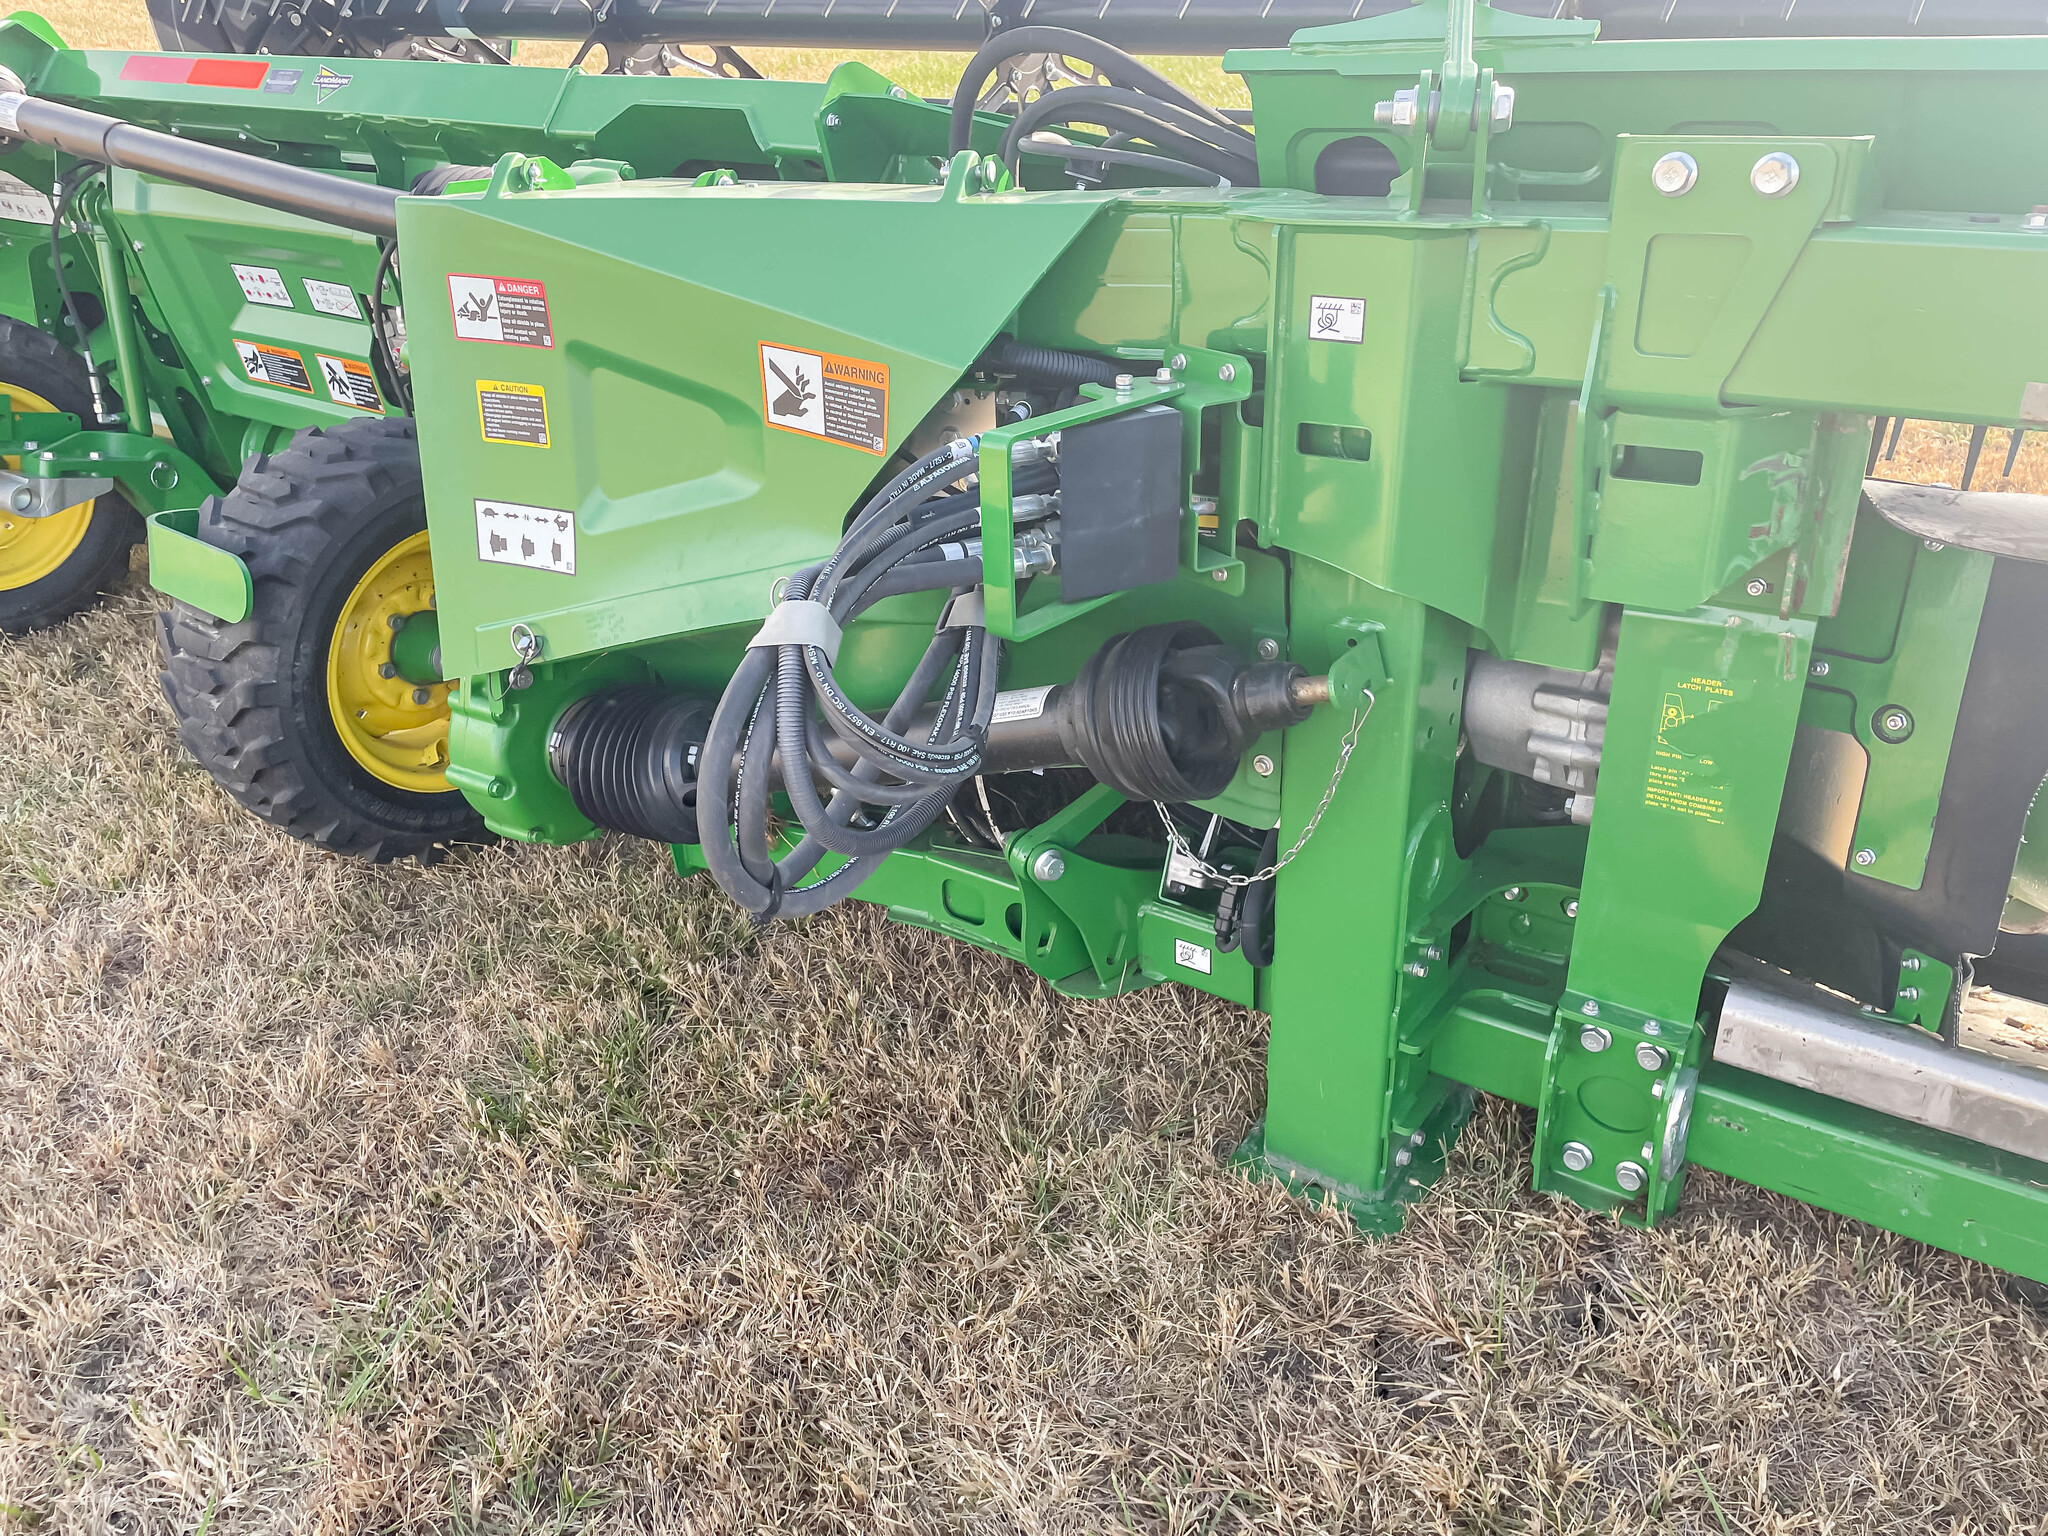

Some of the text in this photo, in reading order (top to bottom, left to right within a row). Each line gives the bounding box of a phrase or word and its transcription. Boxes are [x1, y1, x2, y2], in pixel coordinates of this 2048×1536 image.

[507, 284, 539, 295] DANGER
[834, 363, 884, 384] WARNING
[501, 385, 528, 393] CAUTION
[908, 468, 926, 484] MADE
[919, 457, 971, 487] ALFAGOMMA
[889, 486, 902, 502] ITALY
[816, 672, 825, 682] 10
[1691, 677, 1722, 687] HEADER
[822, 682, 834, 697] DN
[1678, 682, 1734, 696] LATCH PLATES
[832, 697, 847, 713] 1SC
[847, 713, 862, 726] 857
[932, 701, 950, 738] FLEXOPAK
[862, 724, 875, 736] EN
[881, 737, 896, 748] R17
[912, 749, 926, 759] SAE
[1647, 787, 1682, 797] IMPORTANT:
[1684, 794, 1708, 803] HEADER
[1646, 793, 1669, 802] DETACH
[1689, 802, 1716, 812] COMBINE
